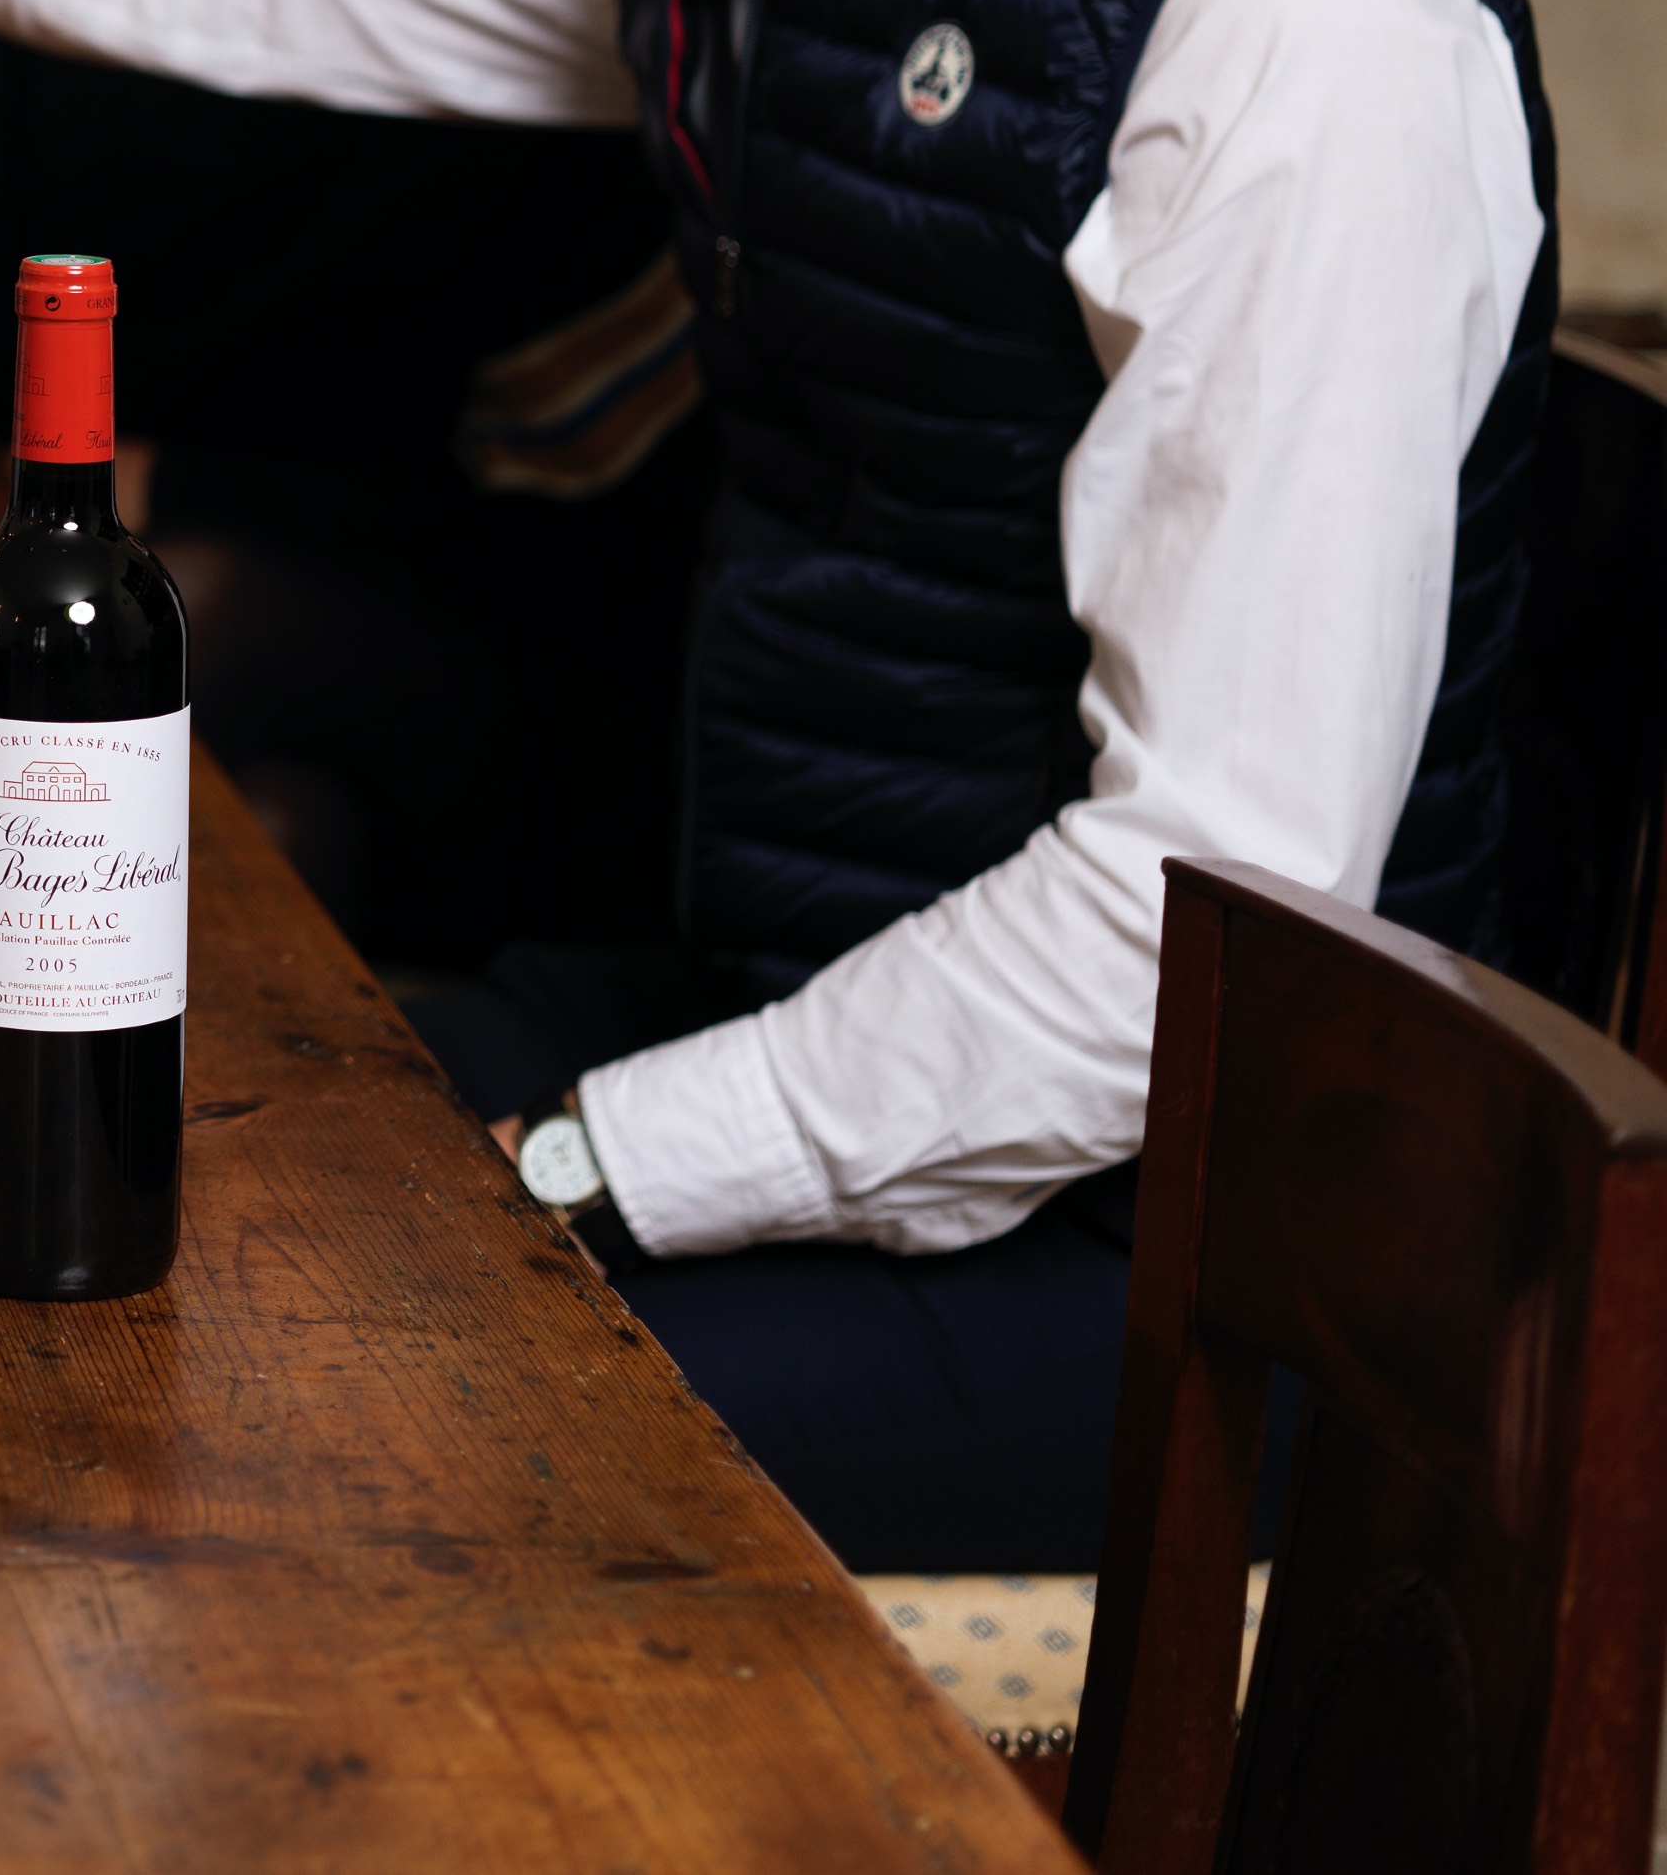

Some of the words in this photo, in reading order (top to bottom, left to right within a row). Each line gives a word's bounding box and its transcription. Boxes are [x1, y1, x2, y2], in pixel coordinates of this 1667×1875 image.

[0, 735, 32, 747] CRU
[41, 735, 104, 750] CLASSÉ
[111, 741, 131, 754] EN
[136, 746, 161, 762] 1855
[34, 935, 79, 946] Pauillac
[82, 933, 132, 946] Contrôlée
[25, 957, 78, 974] 2005
[8, 981, 65, 992] PROPRIETAIRE
[74, 983, 110, 992] PAUILLAC
[115, 978, 150, 990] BORDEAUX
[154, 971, 174, 983] FRANCE
[75, 996, 97, 1008] AU
[102, 988, 161, 1007] CHATEAU
